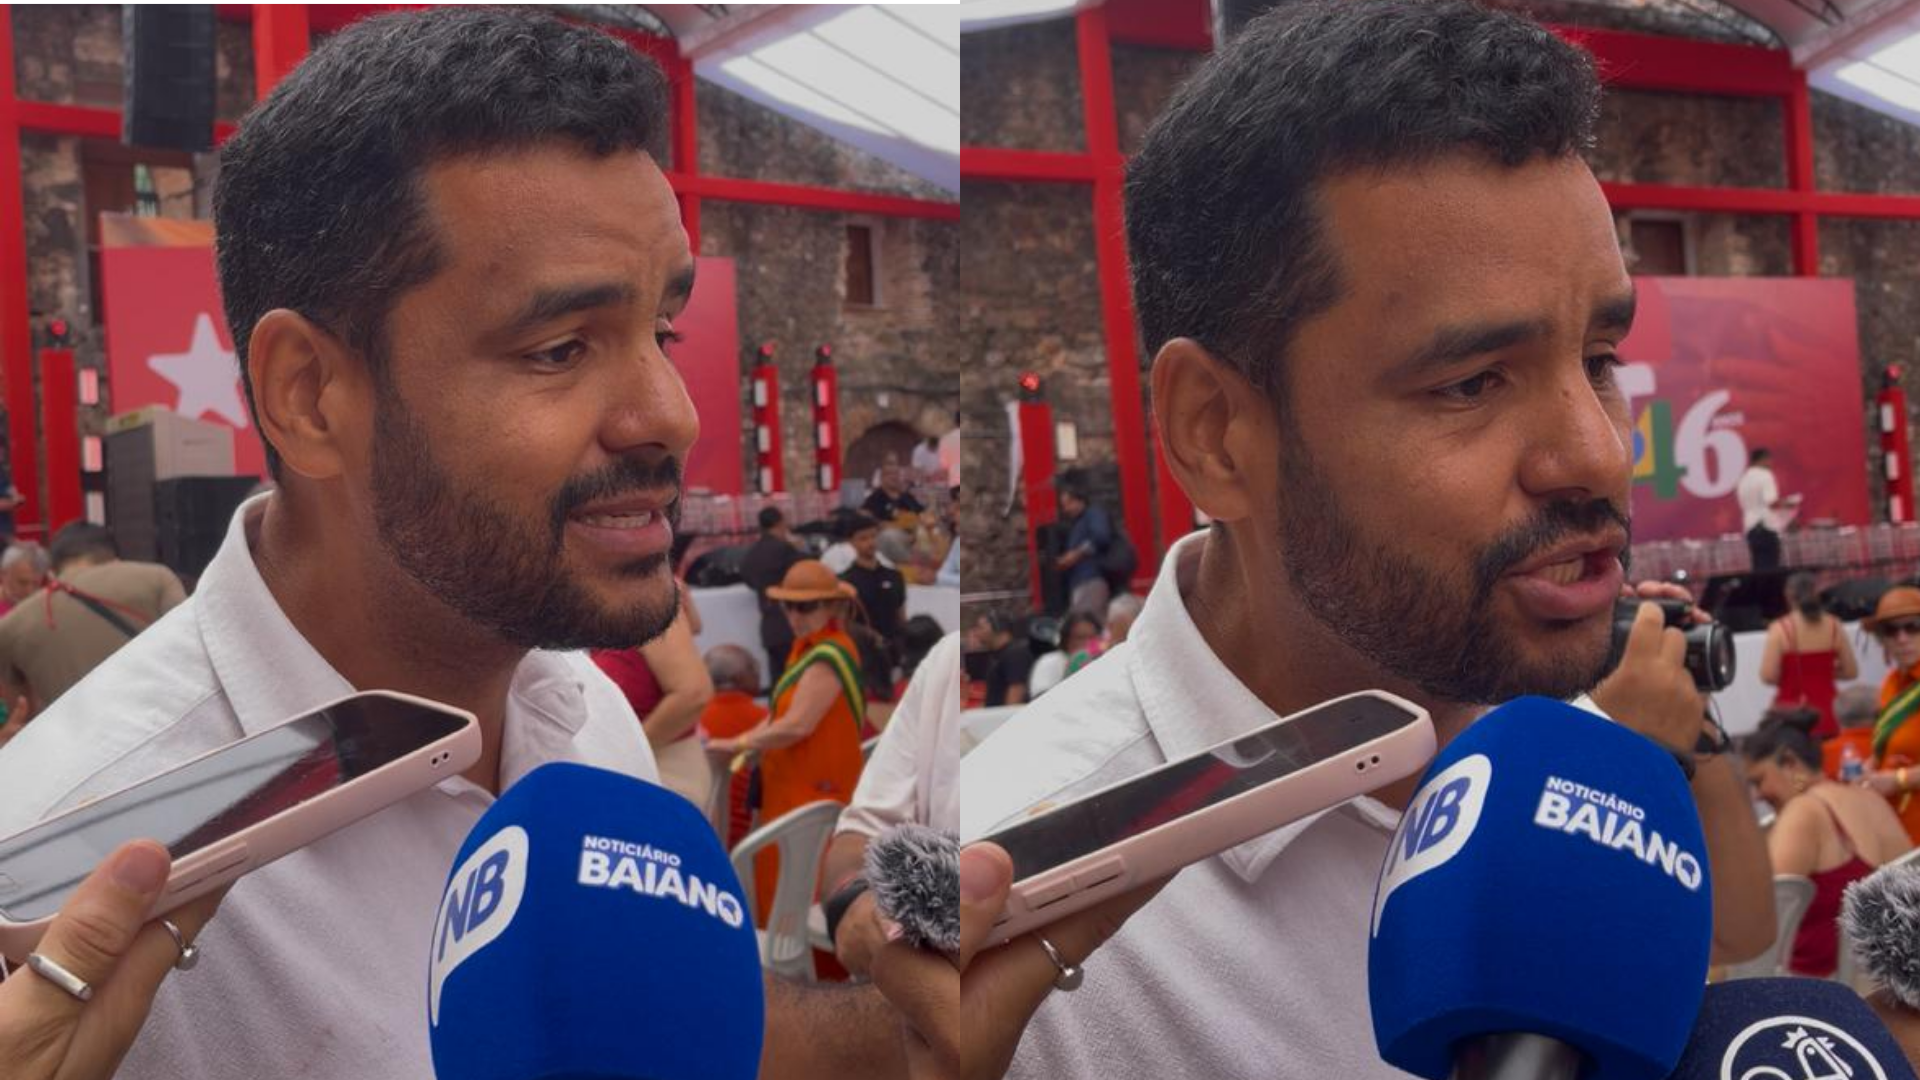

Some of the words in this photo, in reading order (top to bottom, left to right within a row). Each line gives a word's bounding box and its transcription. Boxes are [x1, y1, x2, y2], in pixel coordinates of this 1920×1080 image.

[1387, 776, 1471, 876] NB
[1534, 792, 1701, 891] BAIANO
[1547, 776, 1645, 820] NOTICIÁRIO
[578, 851, 744, 928] BAIANO
[583, 835, 681, 867] NOTICIÁRIO
[438, 849, 510, 963] NB
